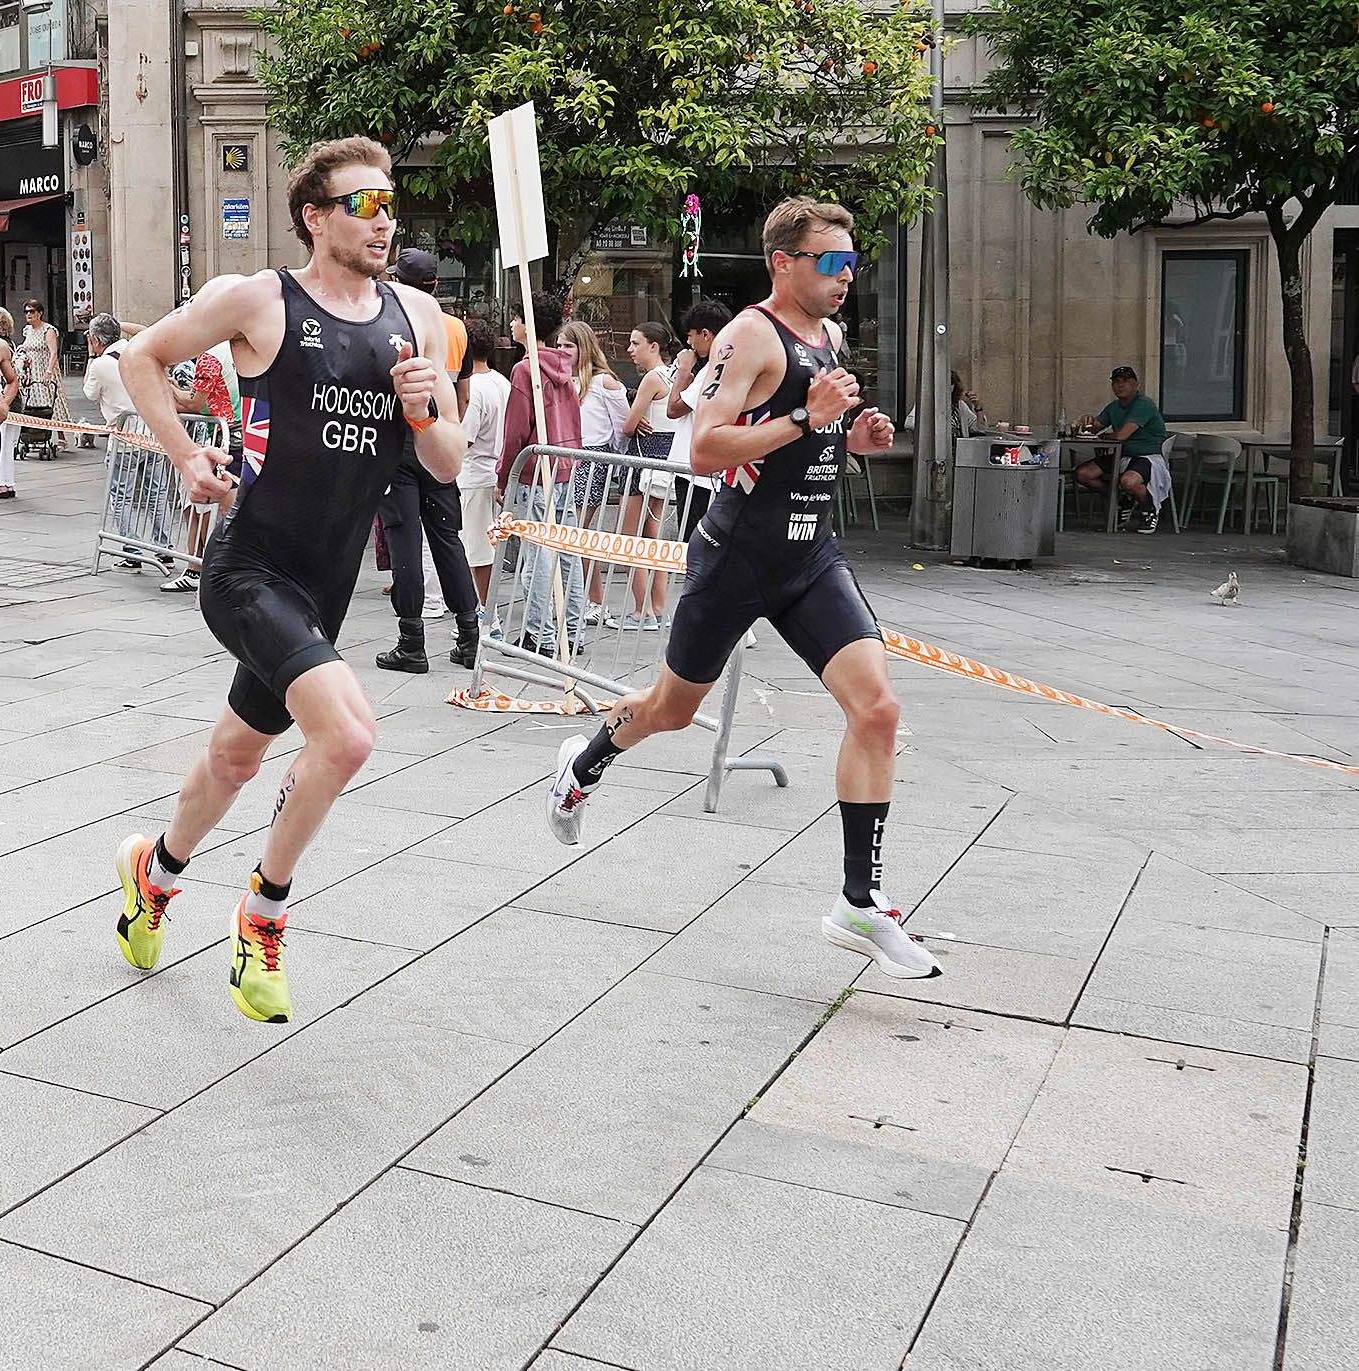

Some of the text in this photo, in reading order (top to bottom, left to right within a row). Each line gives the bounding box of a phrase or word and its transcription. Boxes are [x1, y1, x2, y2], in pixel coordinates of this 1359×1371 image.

[22, 80, 42, 102] FRO
[78, 140, 93, 149] MARCO
[19, 174, 59, 195] MARCO
[299, 341, 324, 349] Triathlon
[311, 383, 398, 421] HODGSON
[322, 420, 378, 456] GBR
[806, 464, 839, 474] BRITISH
[790, 492, 808, 502] Vive
[790, 512, 803, 522] EAT
[787, 521, 817, 541] WIN
